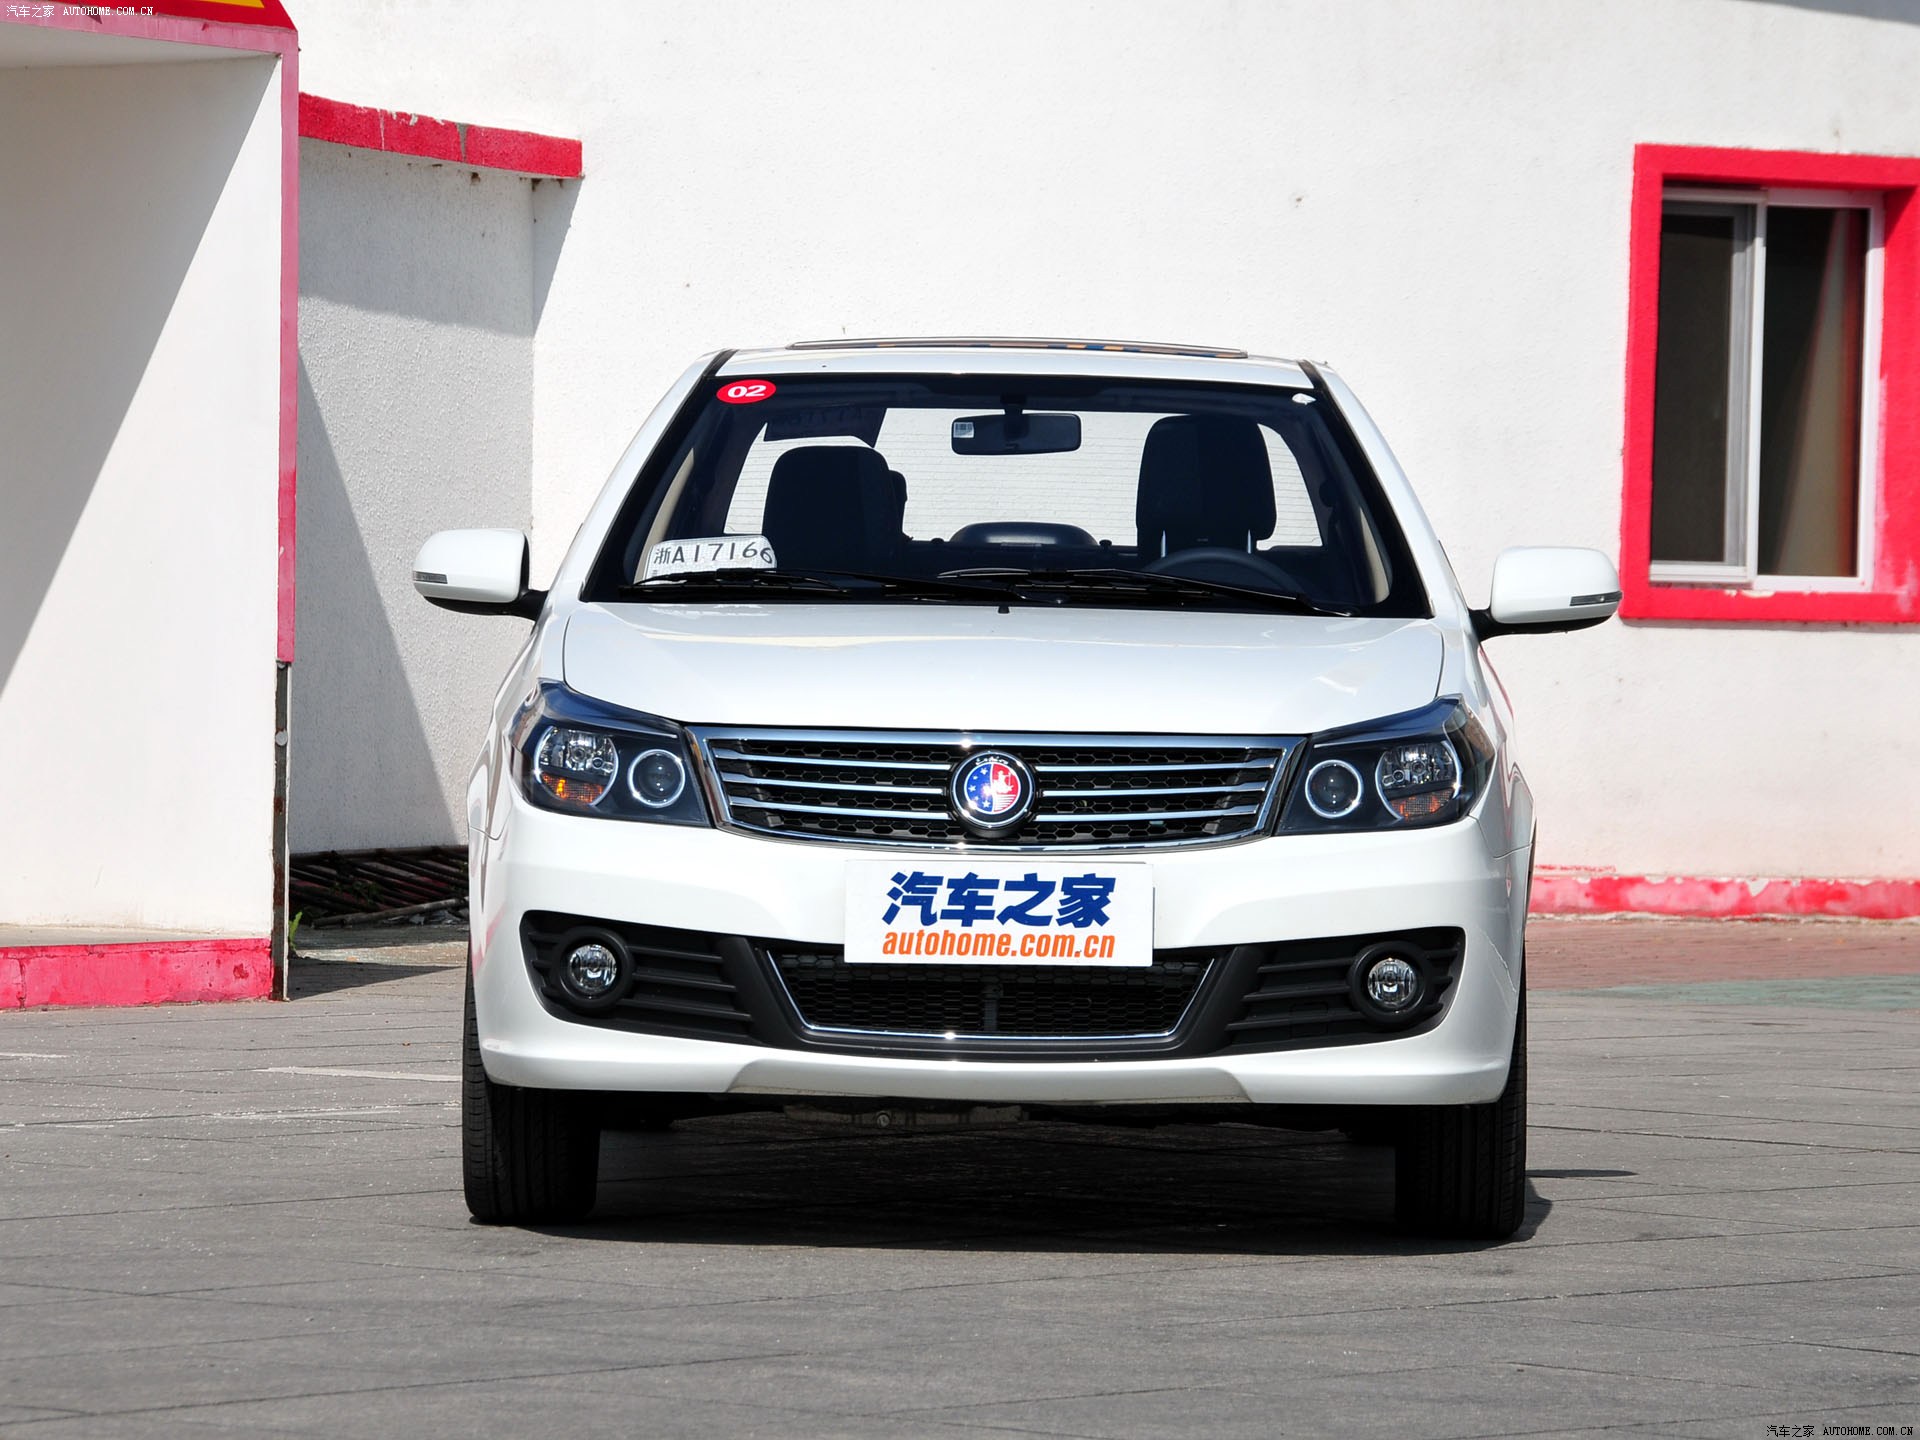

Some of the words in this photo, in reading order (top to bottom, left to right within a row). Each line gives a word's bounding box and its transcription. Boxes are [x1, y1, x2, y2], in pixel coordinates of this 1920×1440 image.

[727, 384, 767, 398] 02
[882, 871, 1116, 928] 汽车之家
[882, 929, 1116, 959] autohome.com.cn
